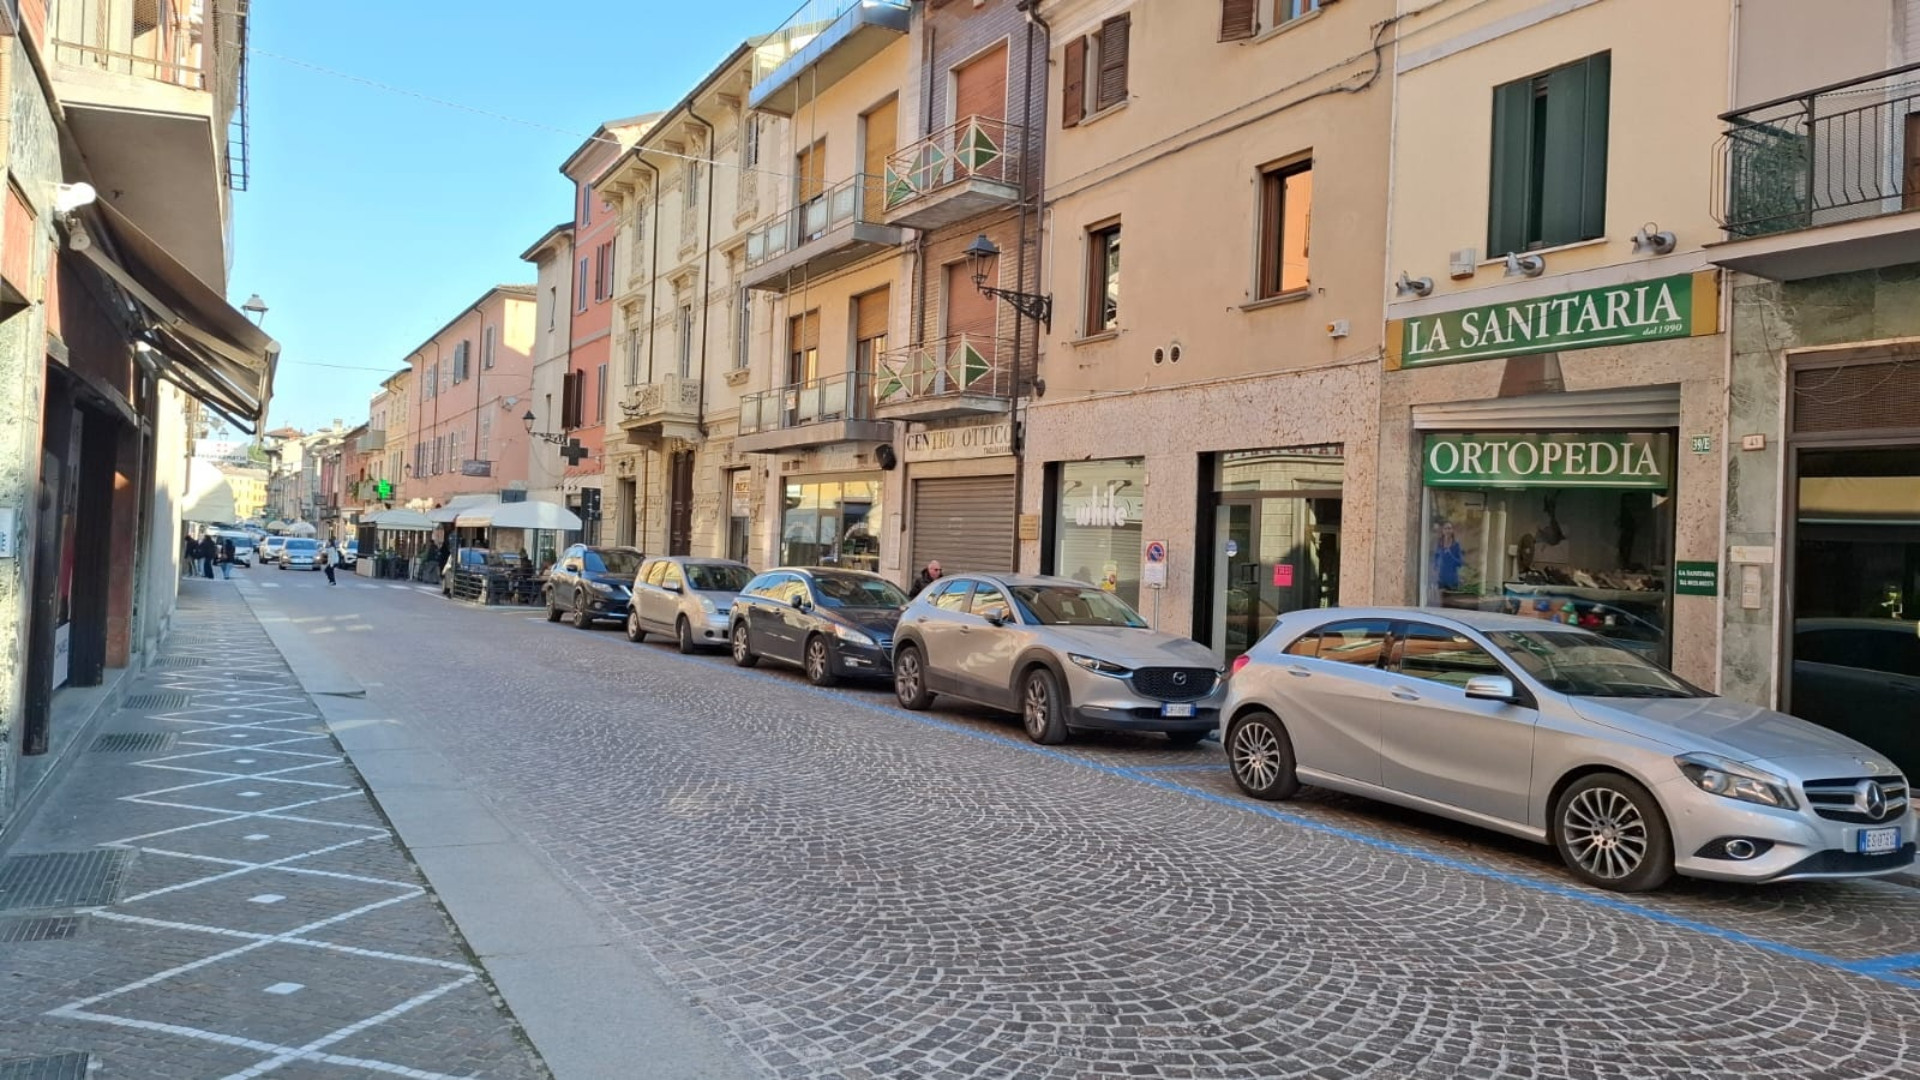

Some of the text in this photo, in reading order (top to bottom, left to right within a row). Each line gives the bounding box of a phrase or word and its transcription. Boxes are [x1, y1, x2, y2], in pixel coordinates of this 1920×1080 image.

[1408, 282, 1682, 355] LA SANITARIA
[1642, 323, 1683, 336] dal 1990
[906, 424, 1012, 452] CENTRO OTTICO
[1429, 441, 1661, 475] ORTOPEDIA
[1075, 484, 1128, 527] white
